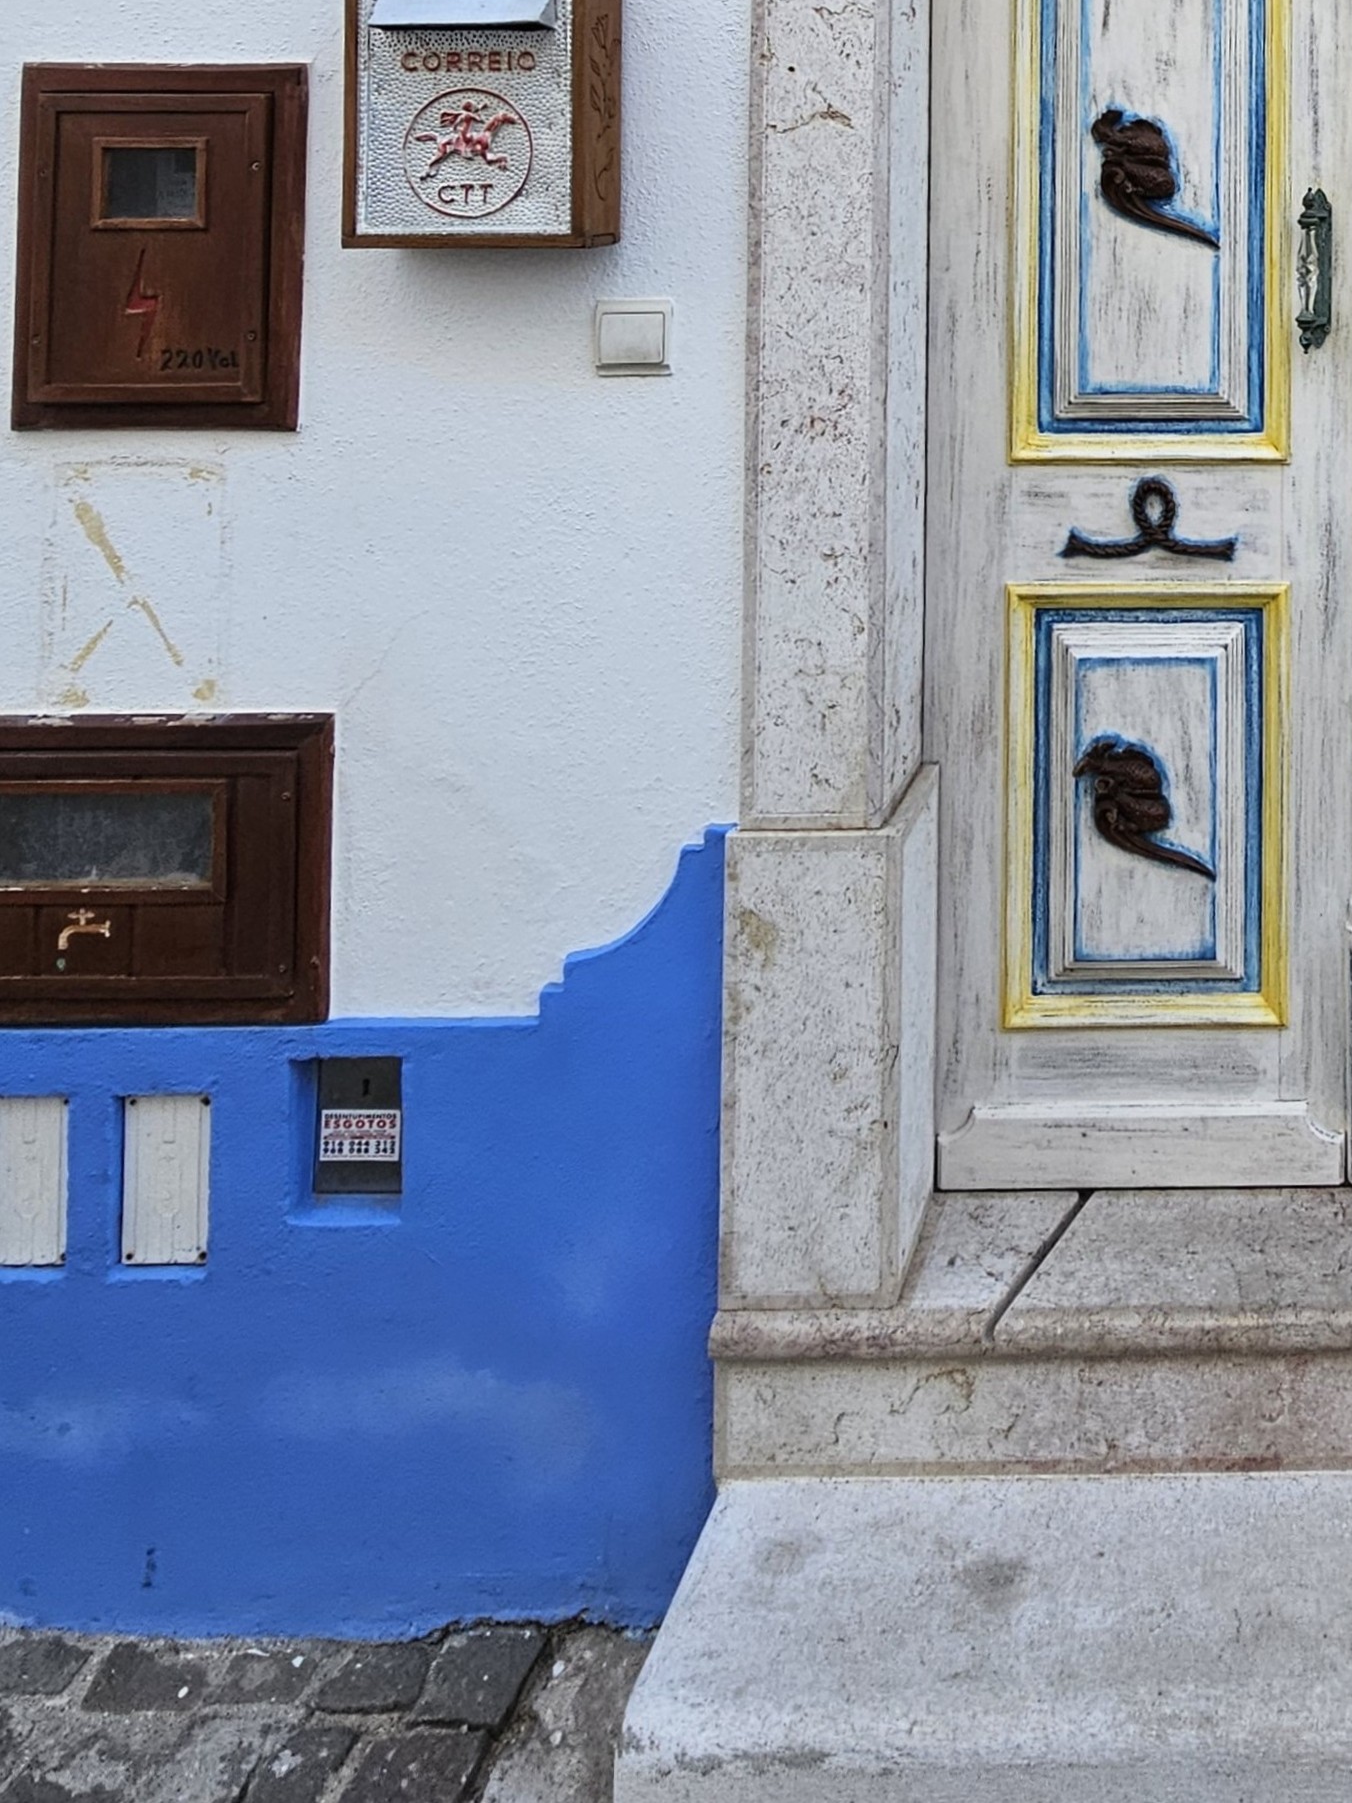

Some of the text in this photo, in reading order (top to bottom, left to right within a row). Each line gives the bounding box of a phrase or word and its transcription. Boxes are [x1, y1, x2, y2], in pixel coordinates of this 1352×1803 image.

[401, 51, 536, 73] CORREIO
[437, 183, 495, 205] CTT
[160, 348, 203, 372] 220
[324, 1119, 397, 1129] ESGOTOS
